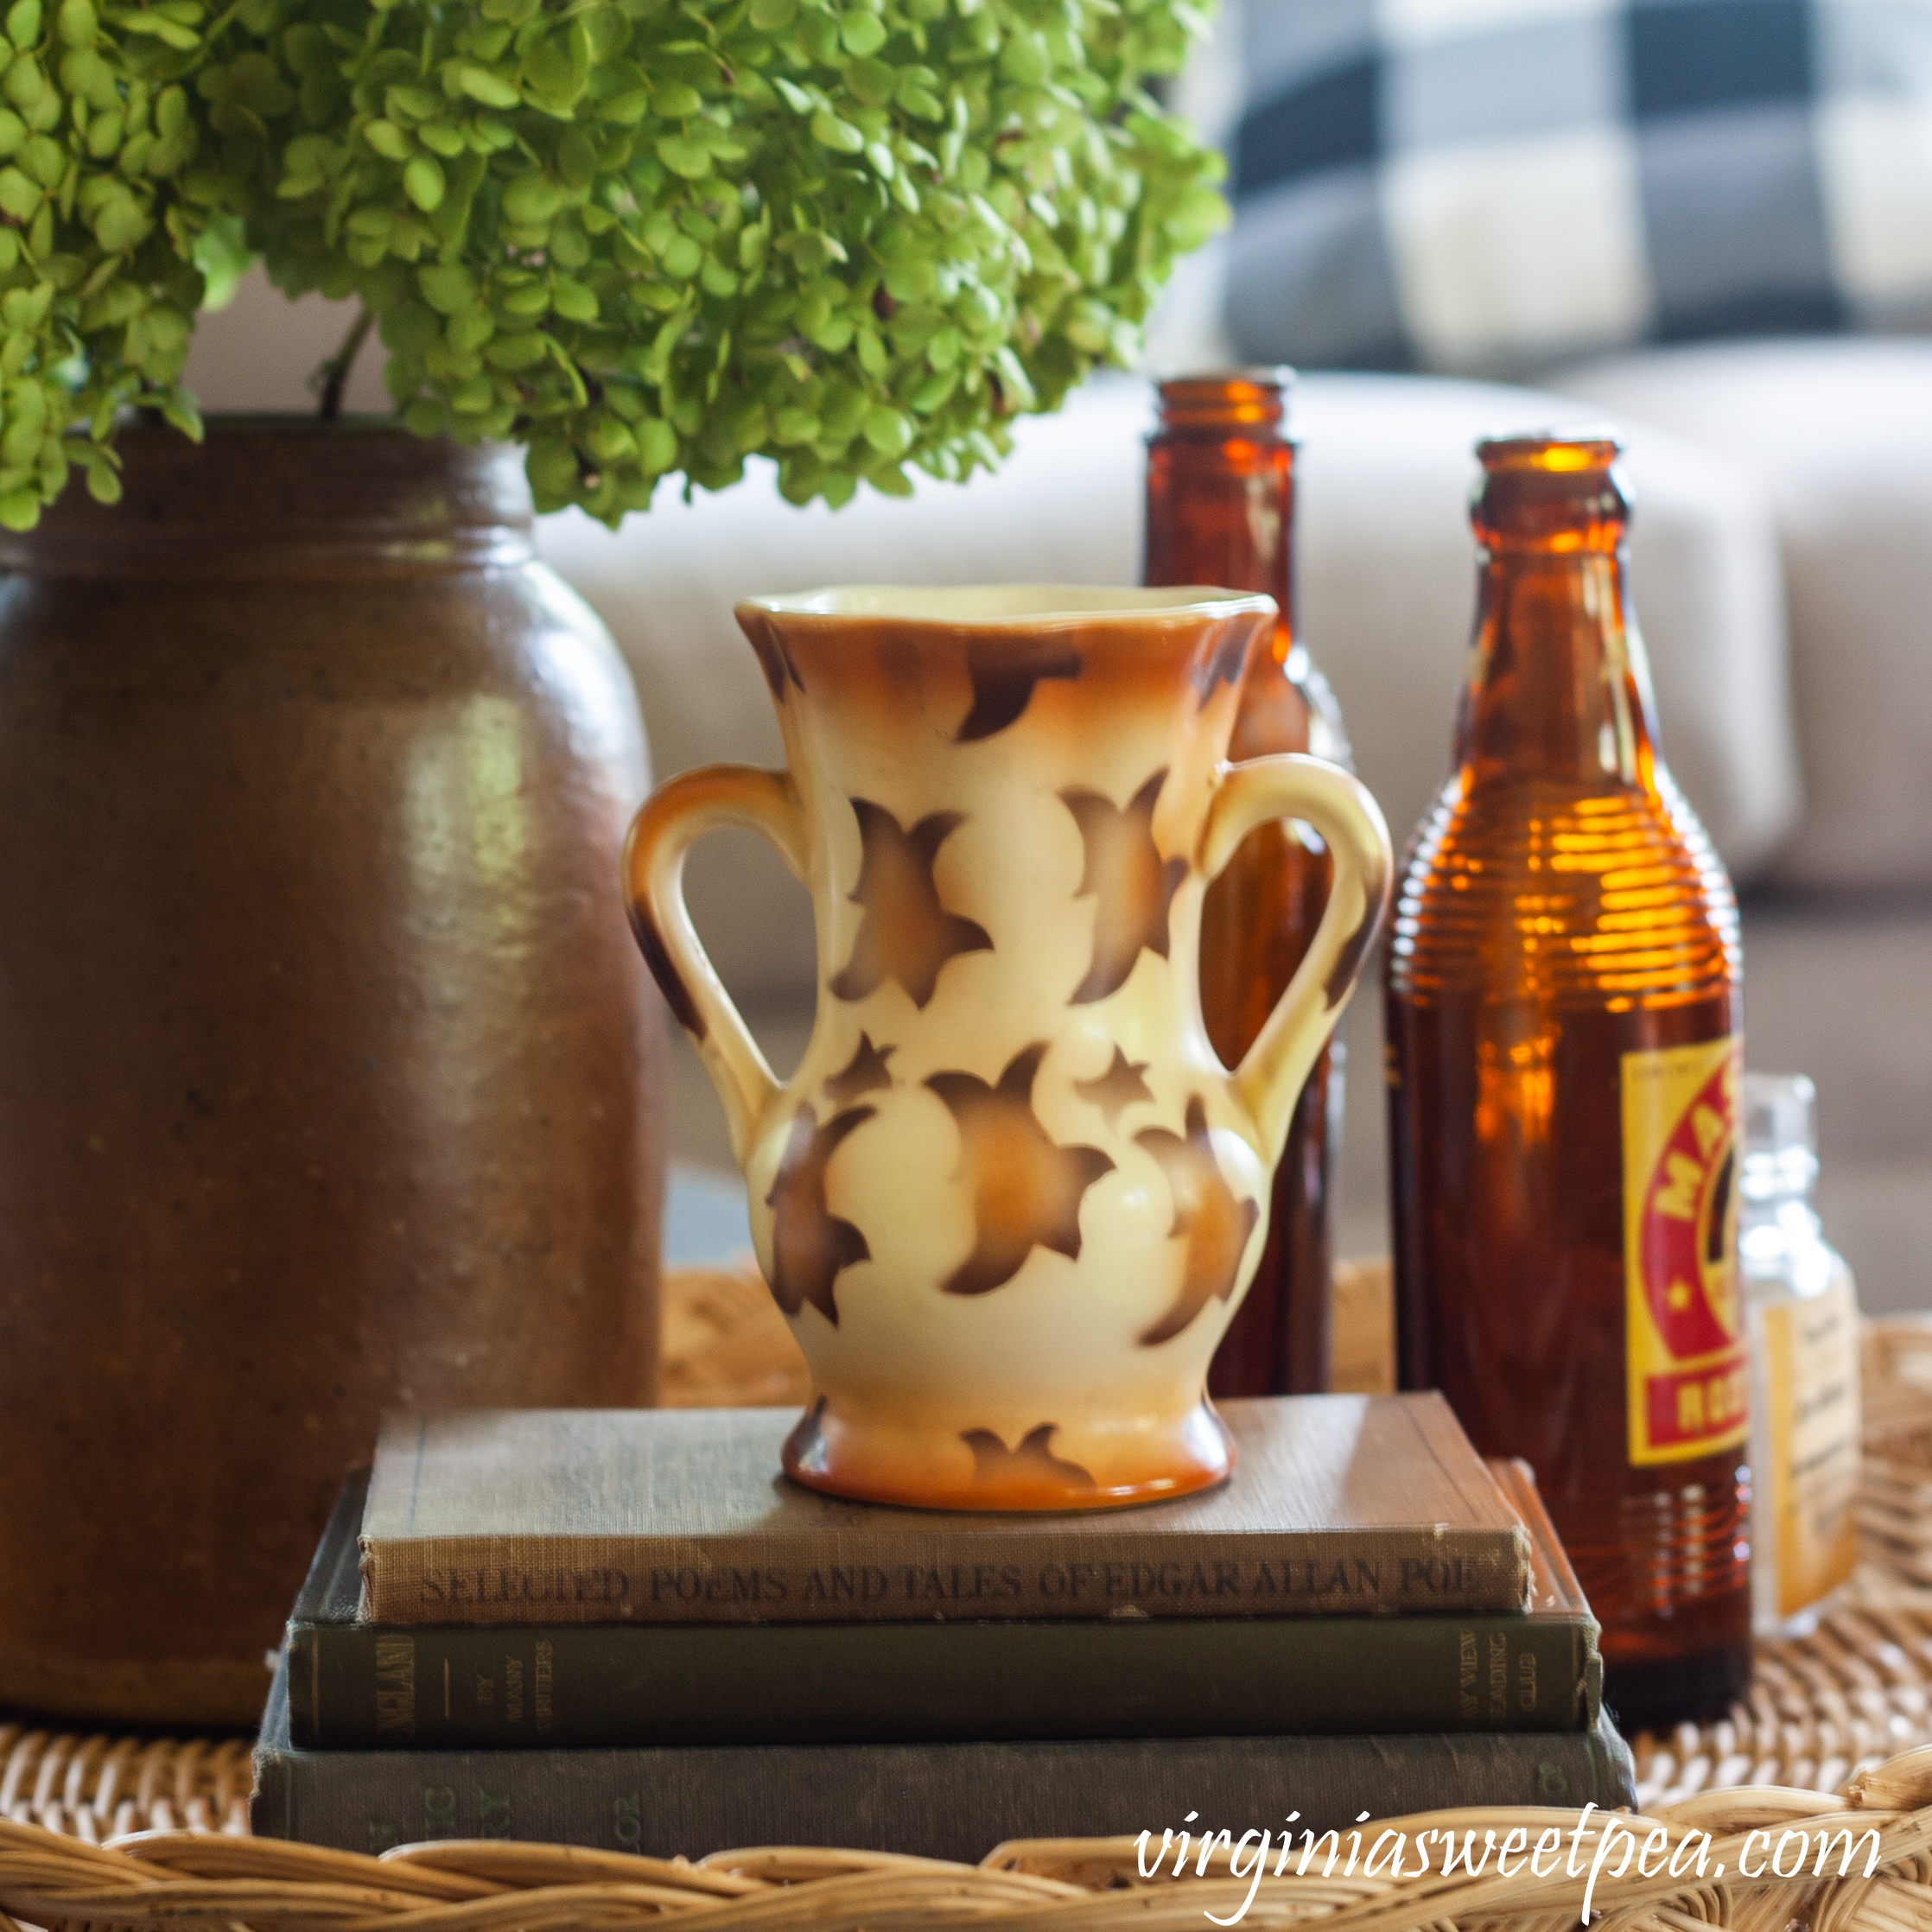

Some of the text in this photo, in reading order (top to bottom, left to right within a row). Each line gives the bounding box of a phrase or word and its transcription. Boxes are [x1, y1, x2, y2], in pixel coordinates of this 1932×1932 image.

[419, 1557, 1478, 1605] SELECTED POEMS AND TALES OF EDGAR ALLAN POE
[376, 1635, 416, 1738] NGLAND
[476, 1674, 494, 1706] BY
